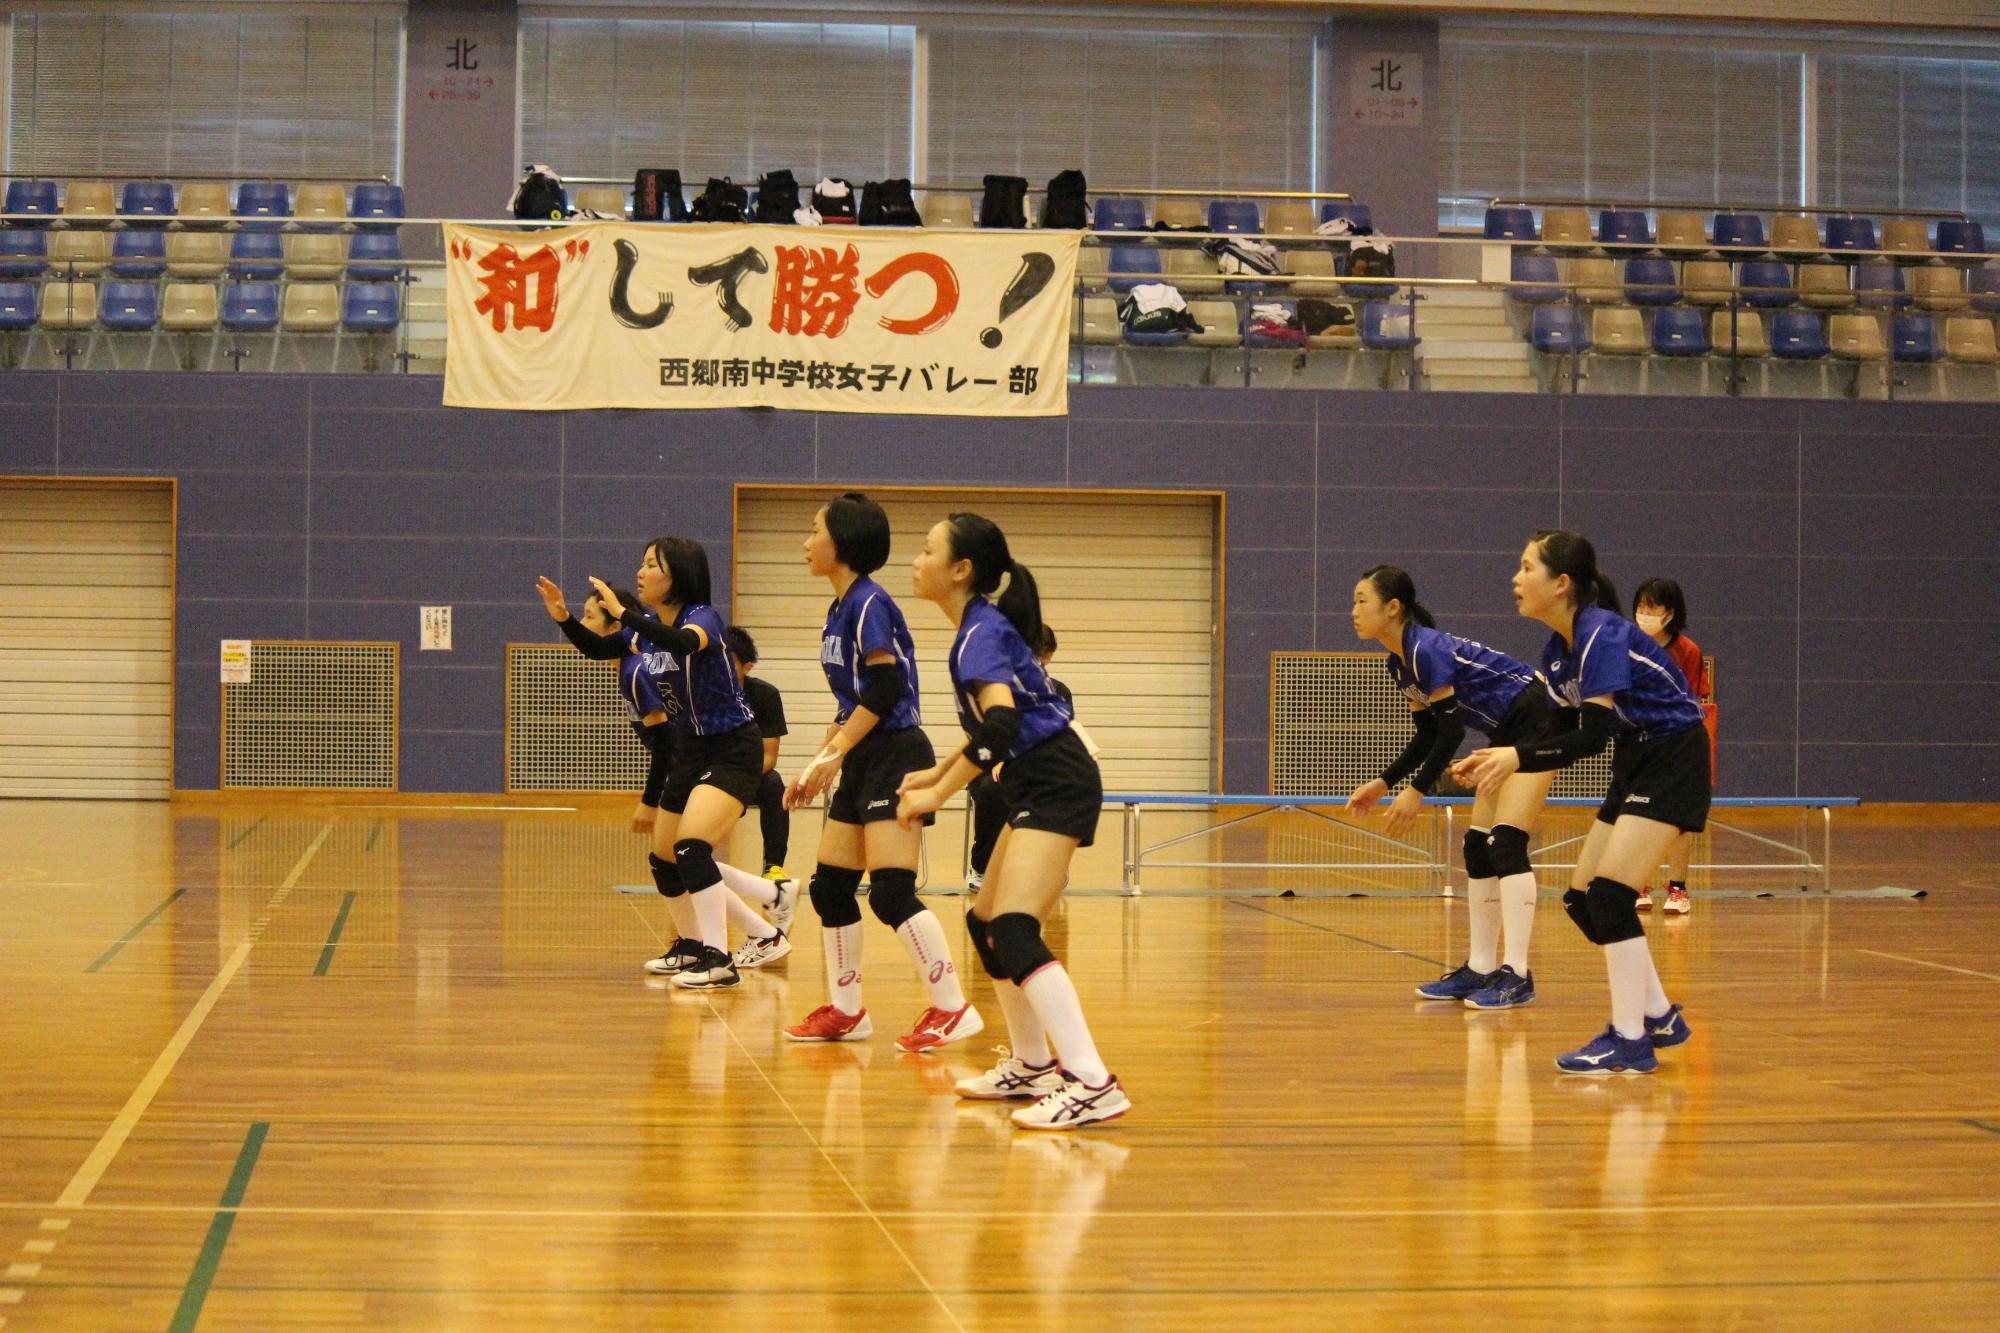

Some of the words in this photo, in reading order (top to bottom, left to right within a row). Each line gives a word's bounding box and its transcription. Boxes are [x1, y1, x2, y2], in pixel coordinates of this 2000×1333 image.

[446, 38, 478, 70] 北
[1370, 59, 1402, 91] 北
[659, 356, 1040, 396] 西郷南中学校女子バレー部
